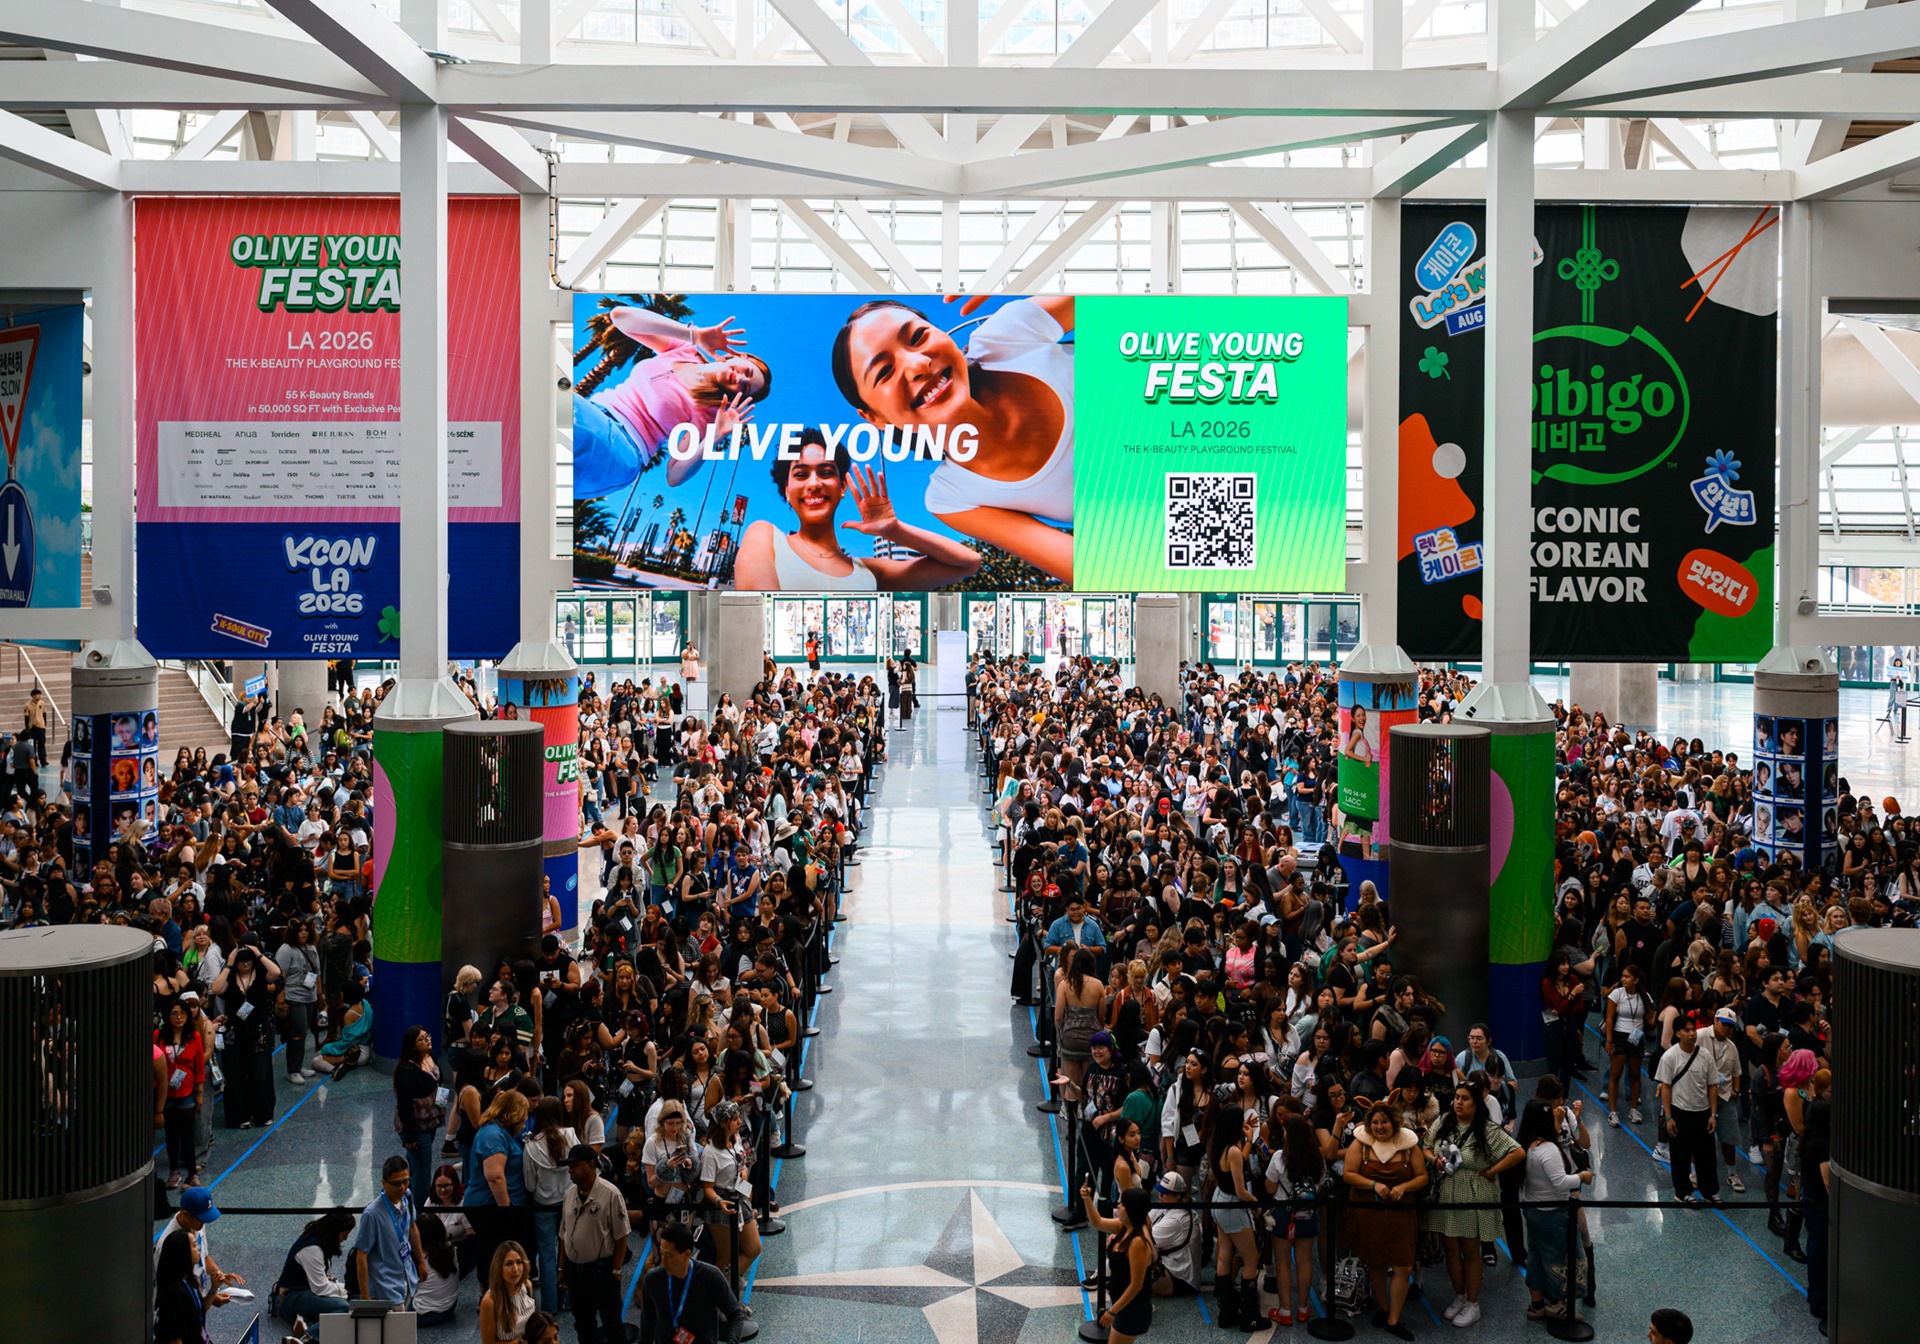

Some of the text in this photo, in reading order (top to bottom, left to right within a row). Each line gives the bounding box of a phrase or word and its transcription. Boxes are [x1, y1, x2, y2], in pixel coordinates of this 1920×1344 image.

[232, 236, 401, 261] OLIVE YOUN
[1424, 232, 1469, 281] 케이콘
[259, 268, 401, 305] FESTA
[1415, 284, 1469, 322] Let's
[1458, 310, 1483, 328] AUG
[287, 332, 373, 350] LA 2026
[1119, 332, 1304, 356] OLIVE YOUNG
[226, 358, 401, 369] THE K-BEAUTY PLAYGROUND FES
[1, 379, 21, 397] SLOW
[1144, 363, 1278, 398] FESTA
[285, 390, 374, 401] 55 K-Beauty Brands
[1532, 364, 1675, 434] ibigo
[248, 405, 401, 414] in 50,000 SQ FT with Exclusive Per
[1171, 421, 1250, 438] LA 2026
[668, 423, 980, 462] OLIVE YOUNG
[1123, 445, 1298, 454] THE K-BEAUTY PLAYGROUND FESTIVAL
[1700, 482, 1749, 517] 안녕!
[285, 536, 376, 568] KCON
[1417, 531, 1456, 558] 렛츠
[1423, 547, 1483, 580] 케이콘!
[311, 567, 350, 592] LA
[1687, 560, 1749, 607] 맛있다
[299, 593, 363, 613] 2026
[219, 619, 265, 642] K-SOUL CITY
[324, 622, 338, 630] with
[303, 634, 359, 642] OLIVE YOUNG
[311, 642, 352, 653] FESTA
[544, 743, 577, 759] OLIVE
